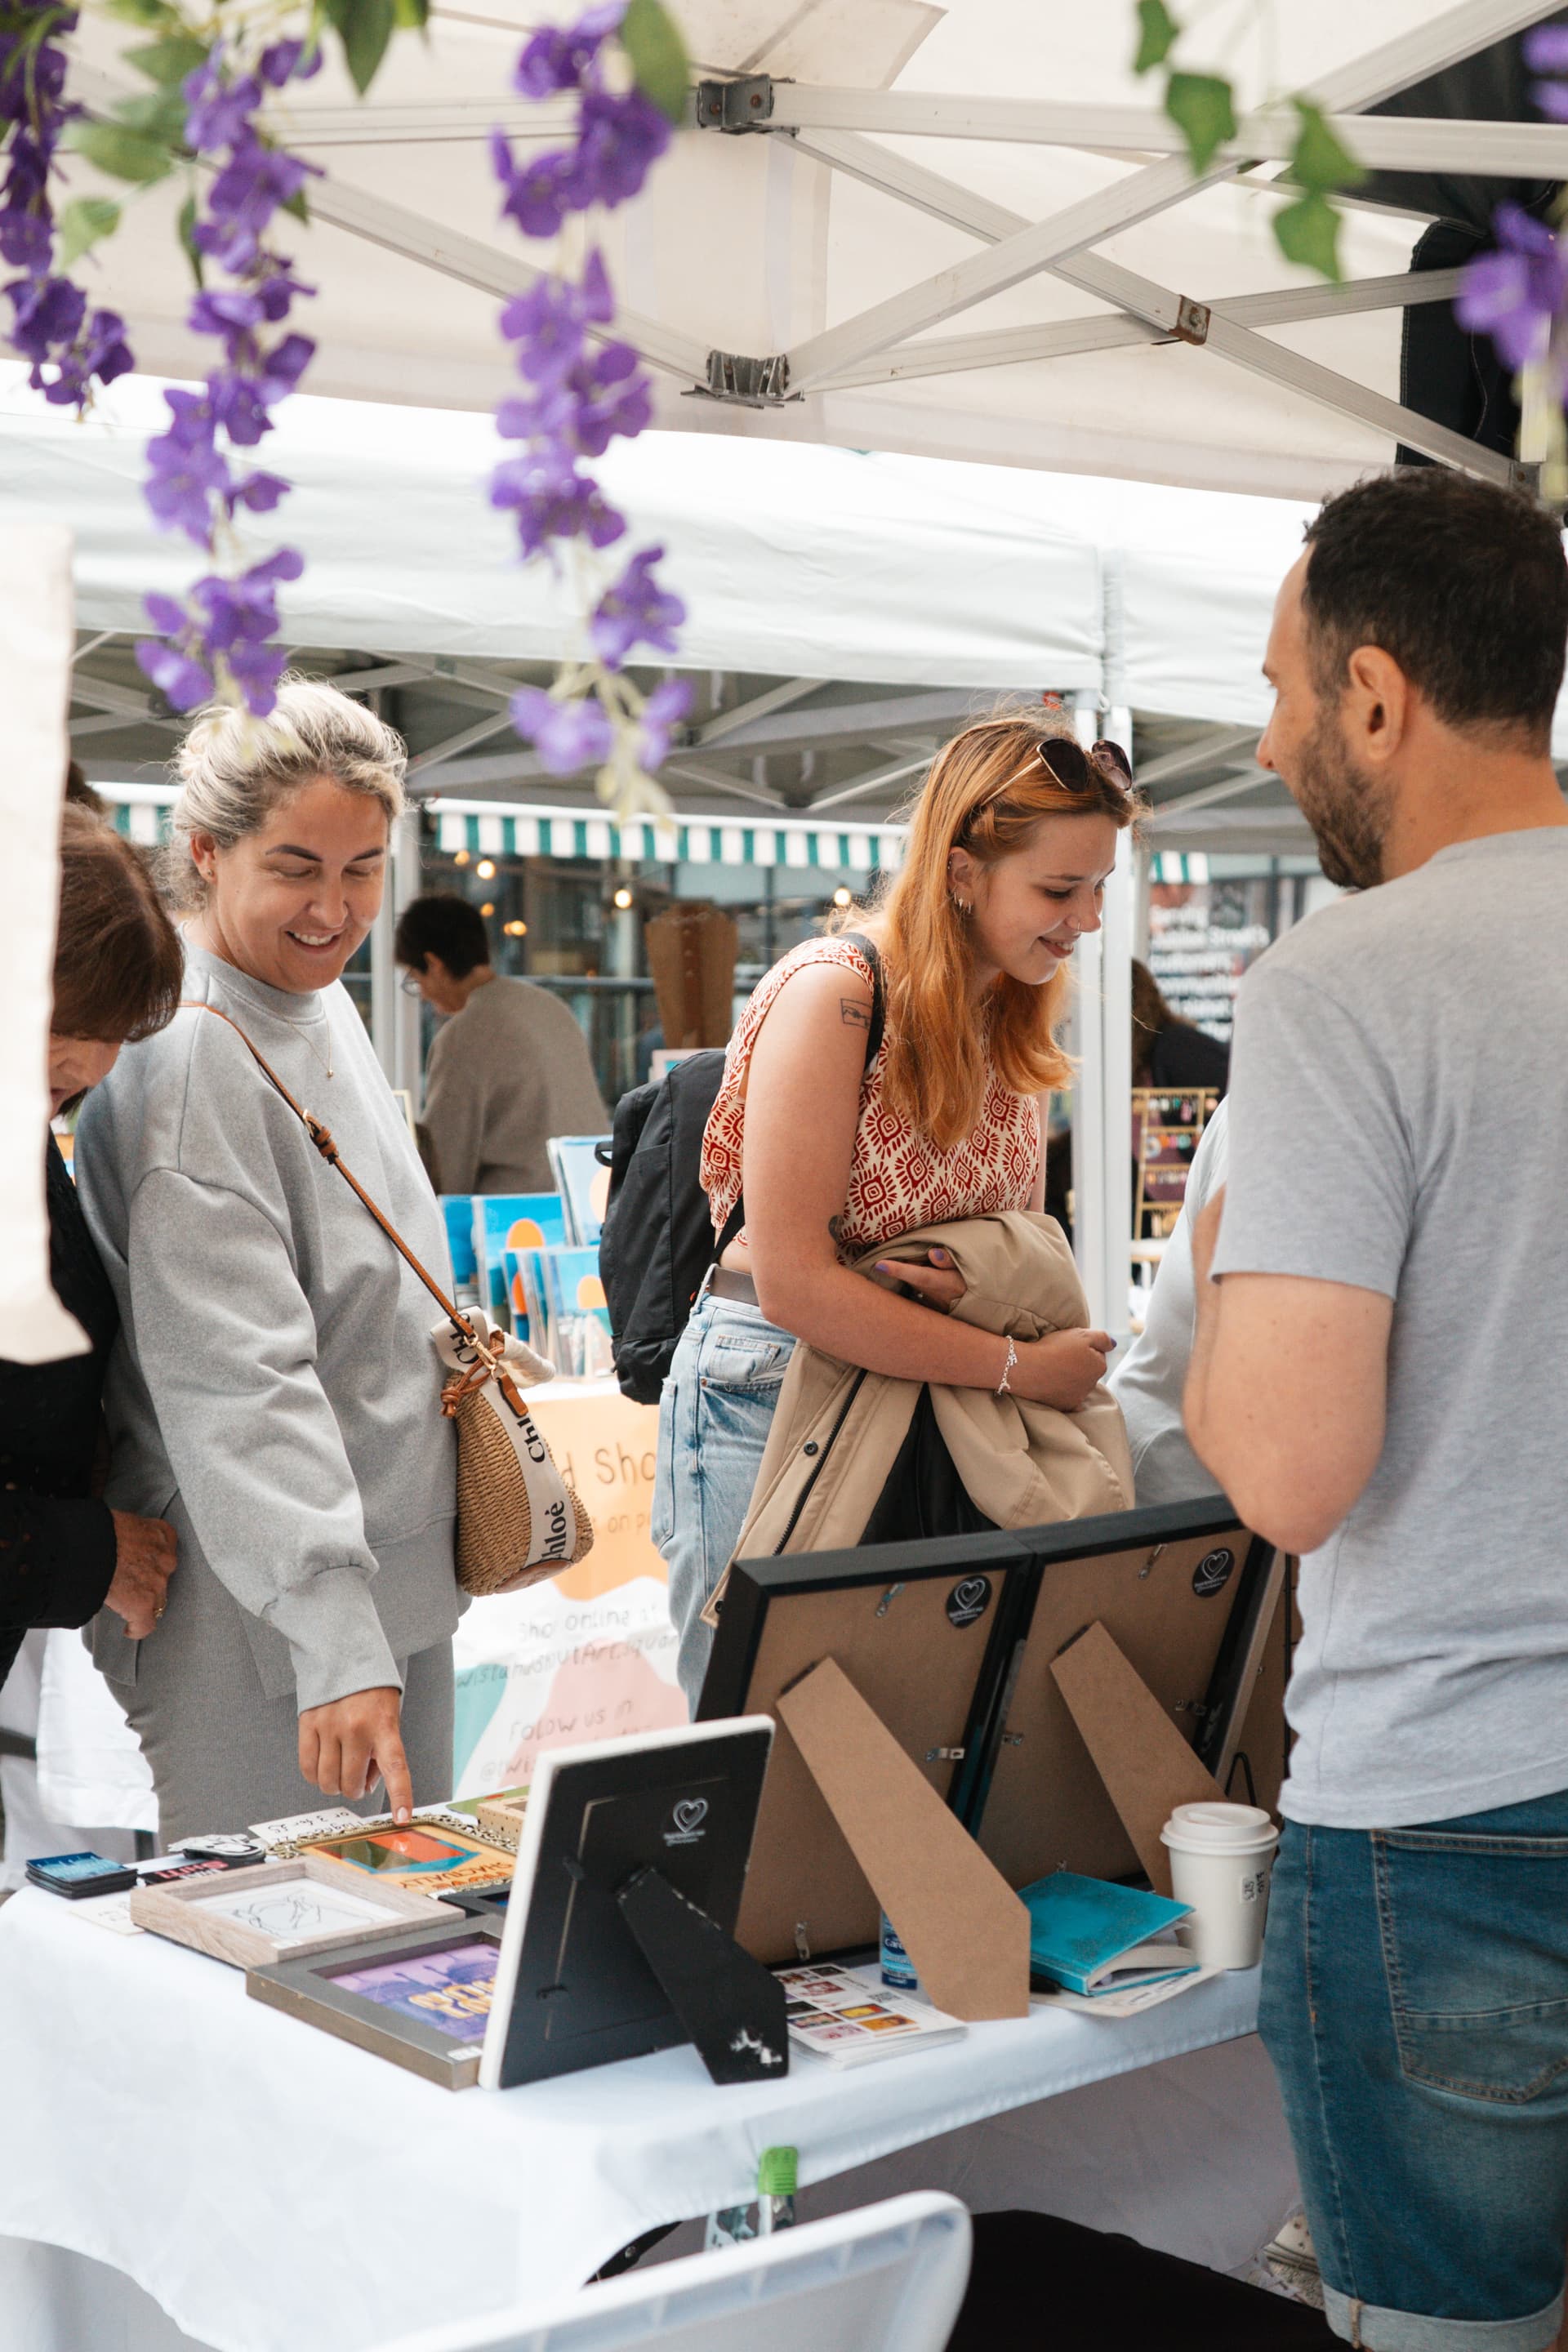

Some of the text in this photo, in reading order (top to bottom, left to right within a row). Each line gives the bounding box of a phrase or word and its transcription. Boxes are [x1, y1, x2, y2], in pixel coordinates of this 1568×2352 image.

[517, 1418, 545, 1463] Chl
[595, 1441, 656, 1485] Sho
[541, 1500, 567, 1561] hloé
